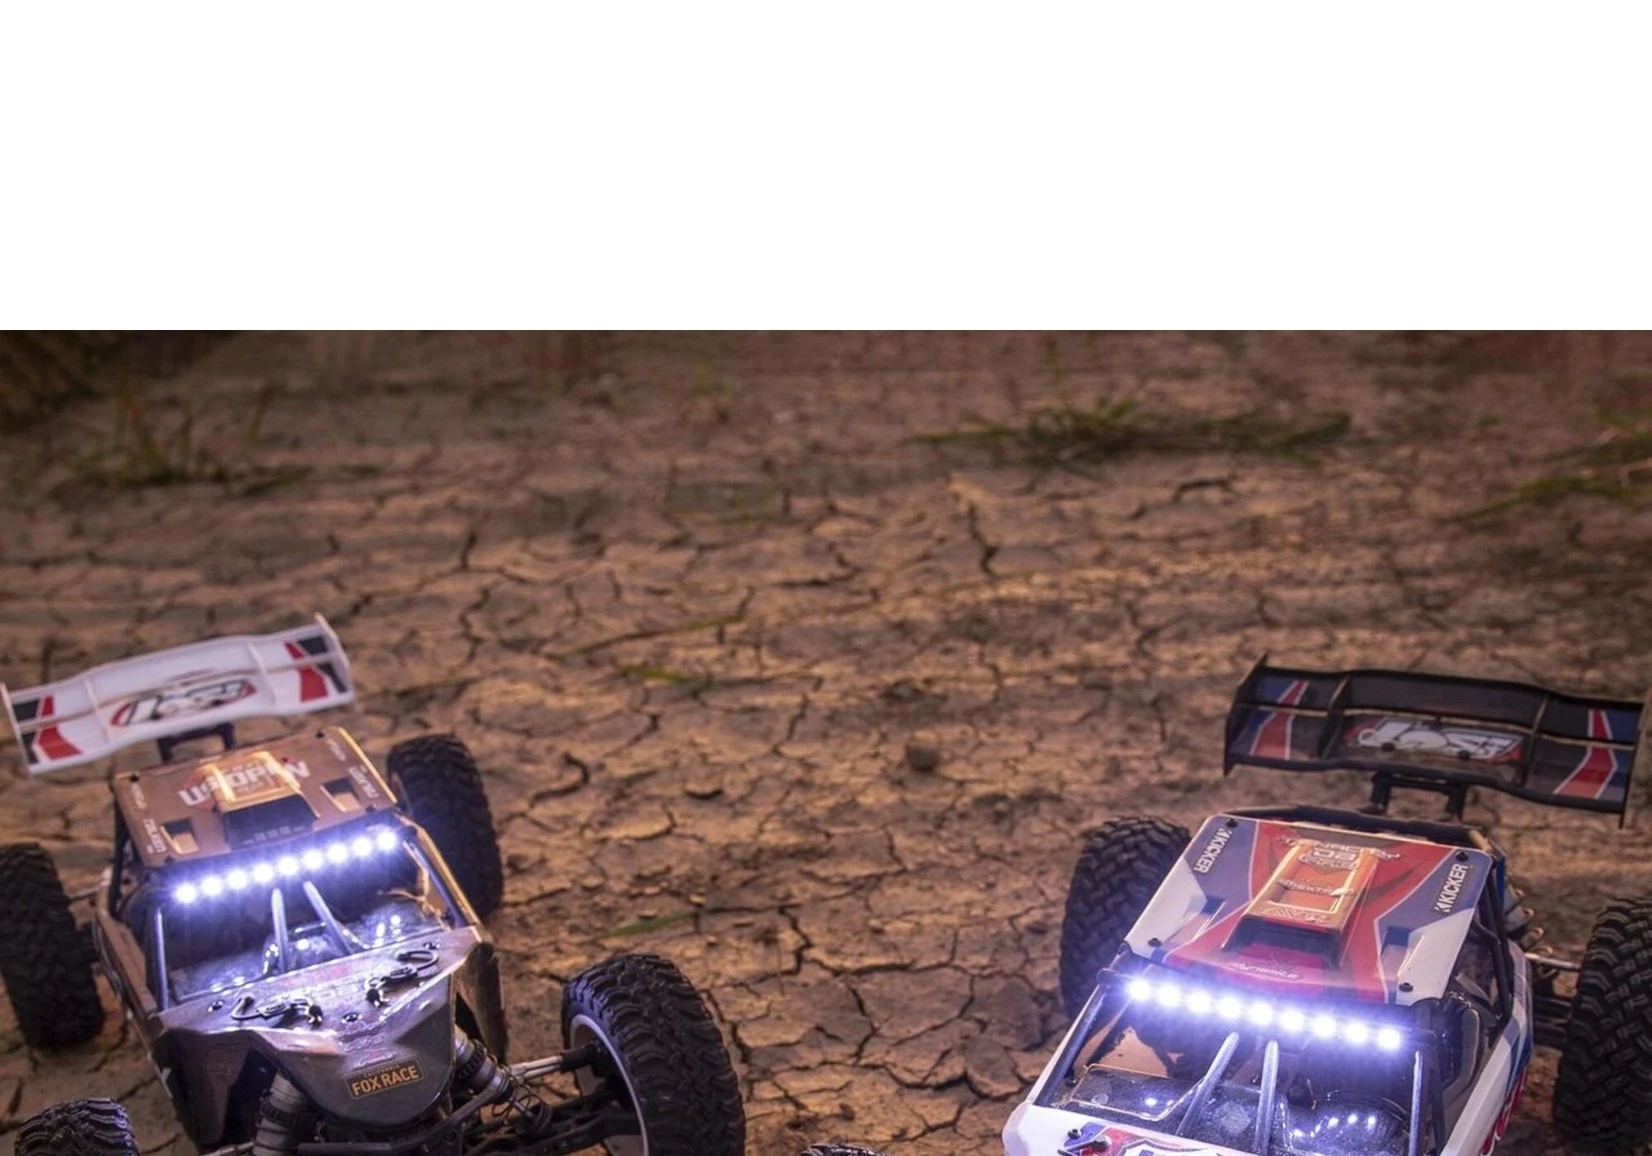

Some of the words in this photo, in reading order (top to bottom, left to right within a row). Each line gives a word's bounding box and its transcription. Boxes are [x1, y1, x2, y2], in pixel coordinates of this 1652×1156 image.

[1193, 829, 1231, 873] KICKER
[1437, 863, 1469, 907] KICKER
[351, 1076, 381, 1096] FOX
[381, 1065, 419, 1087] RACE
